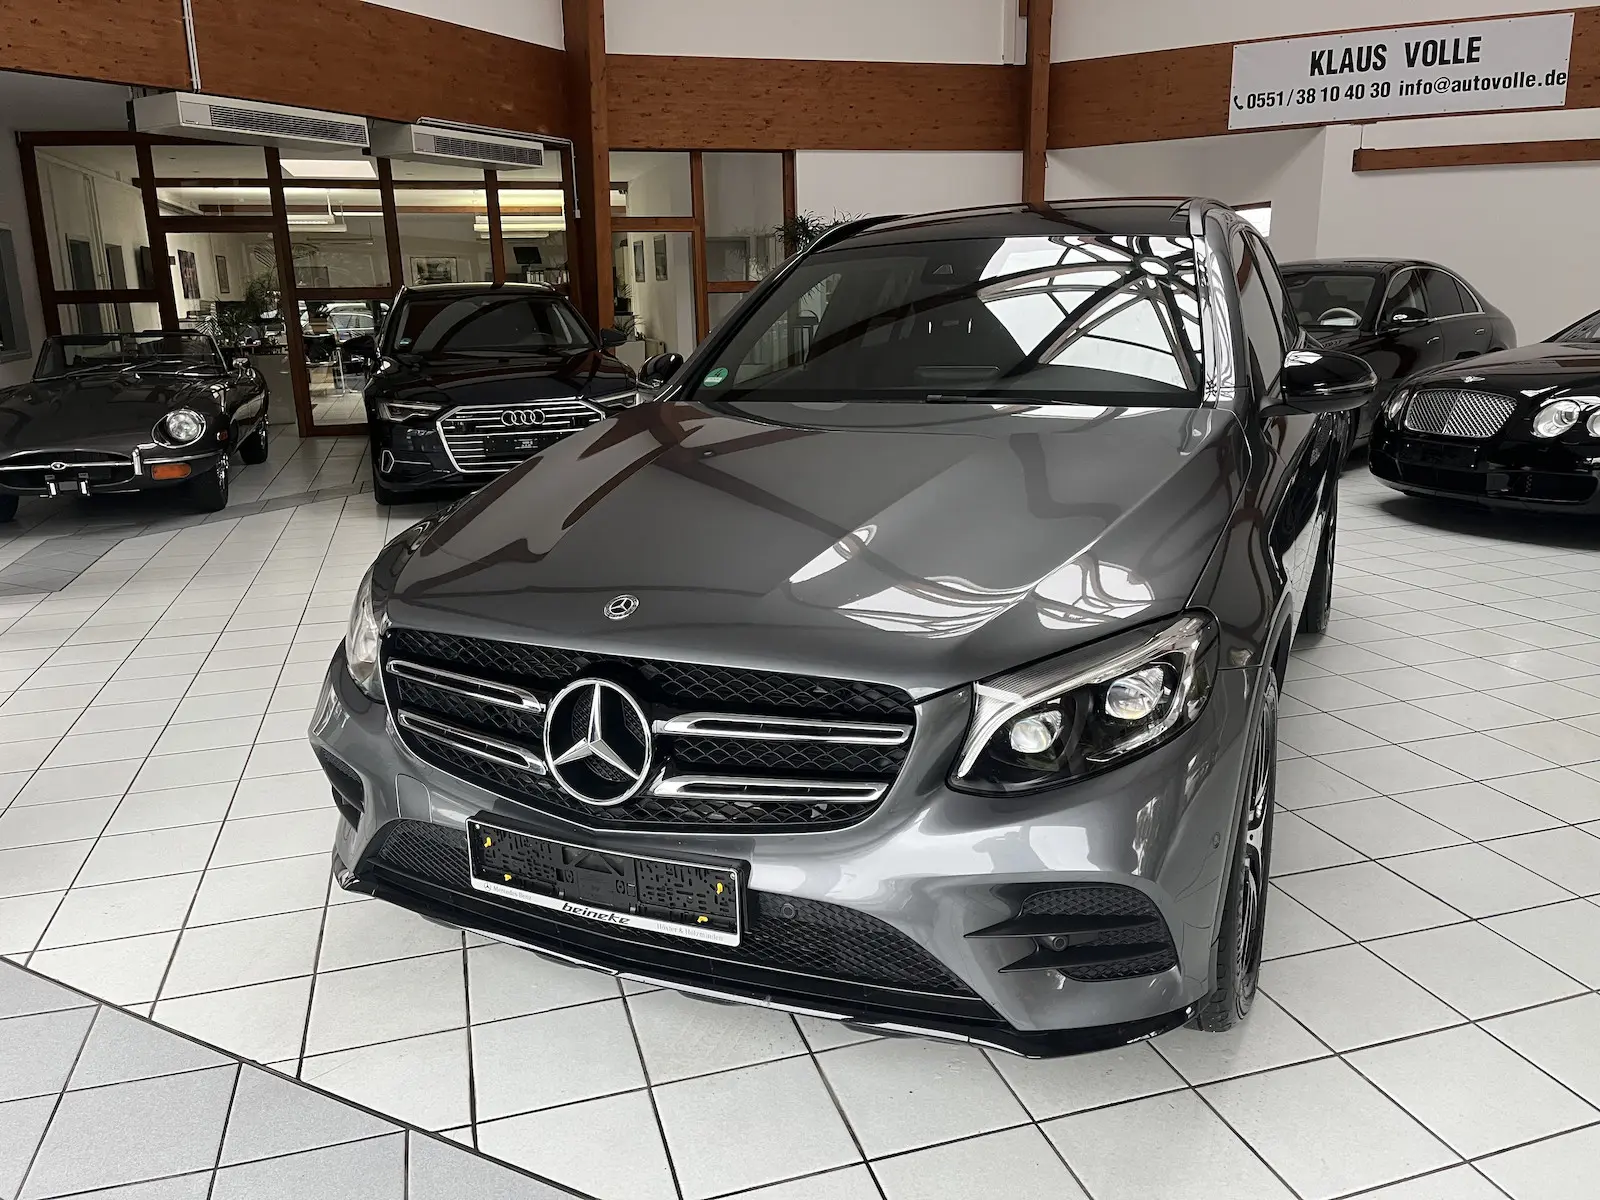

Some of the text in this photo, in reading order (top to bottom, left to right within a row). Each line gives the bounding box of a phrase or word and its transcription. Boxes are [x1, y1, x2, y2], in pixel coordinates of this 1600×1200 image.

[1309, 35, 1482, 77] KLAUS VOLLE
[1320, 85, 1340, 103] 10
[1344, 83, 1365, 100] 40
[1369, 81, 1391, 99] 30
[1399, 68, 1568, 97] info@autovolle.de
[562, 902, 631, 925] beineke
